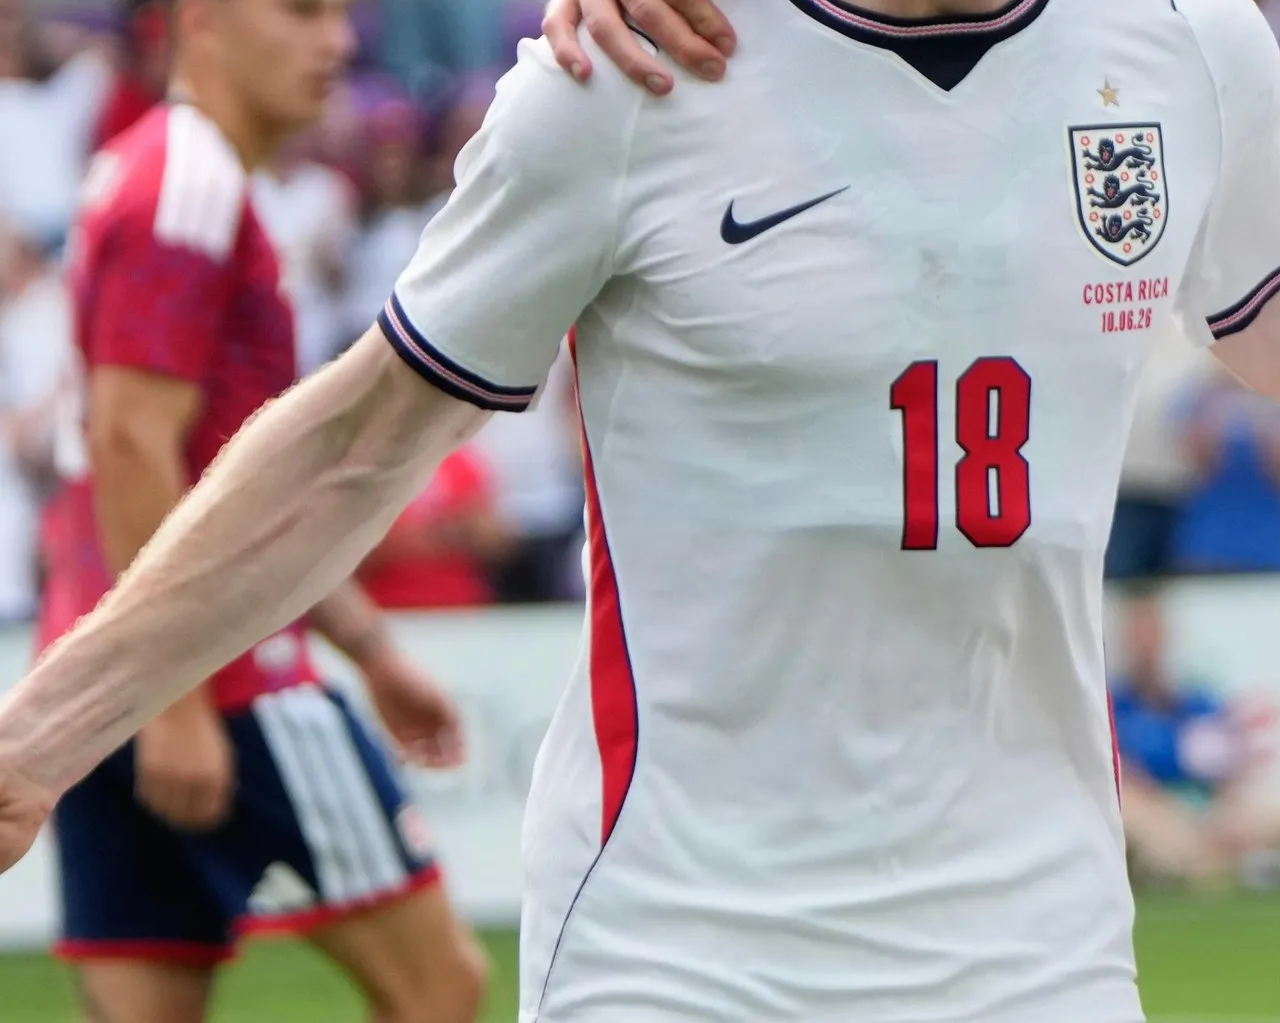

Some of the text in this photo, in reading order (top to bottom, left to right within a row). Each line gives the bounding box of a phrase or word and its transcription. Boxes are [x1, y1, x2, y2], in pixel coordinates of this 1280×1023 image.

[1083, 276, 1168, 305] COSTA RICA
[1101, 307, 1153, 333] 10.06.26
[889, 356, 1032, 550] 18
